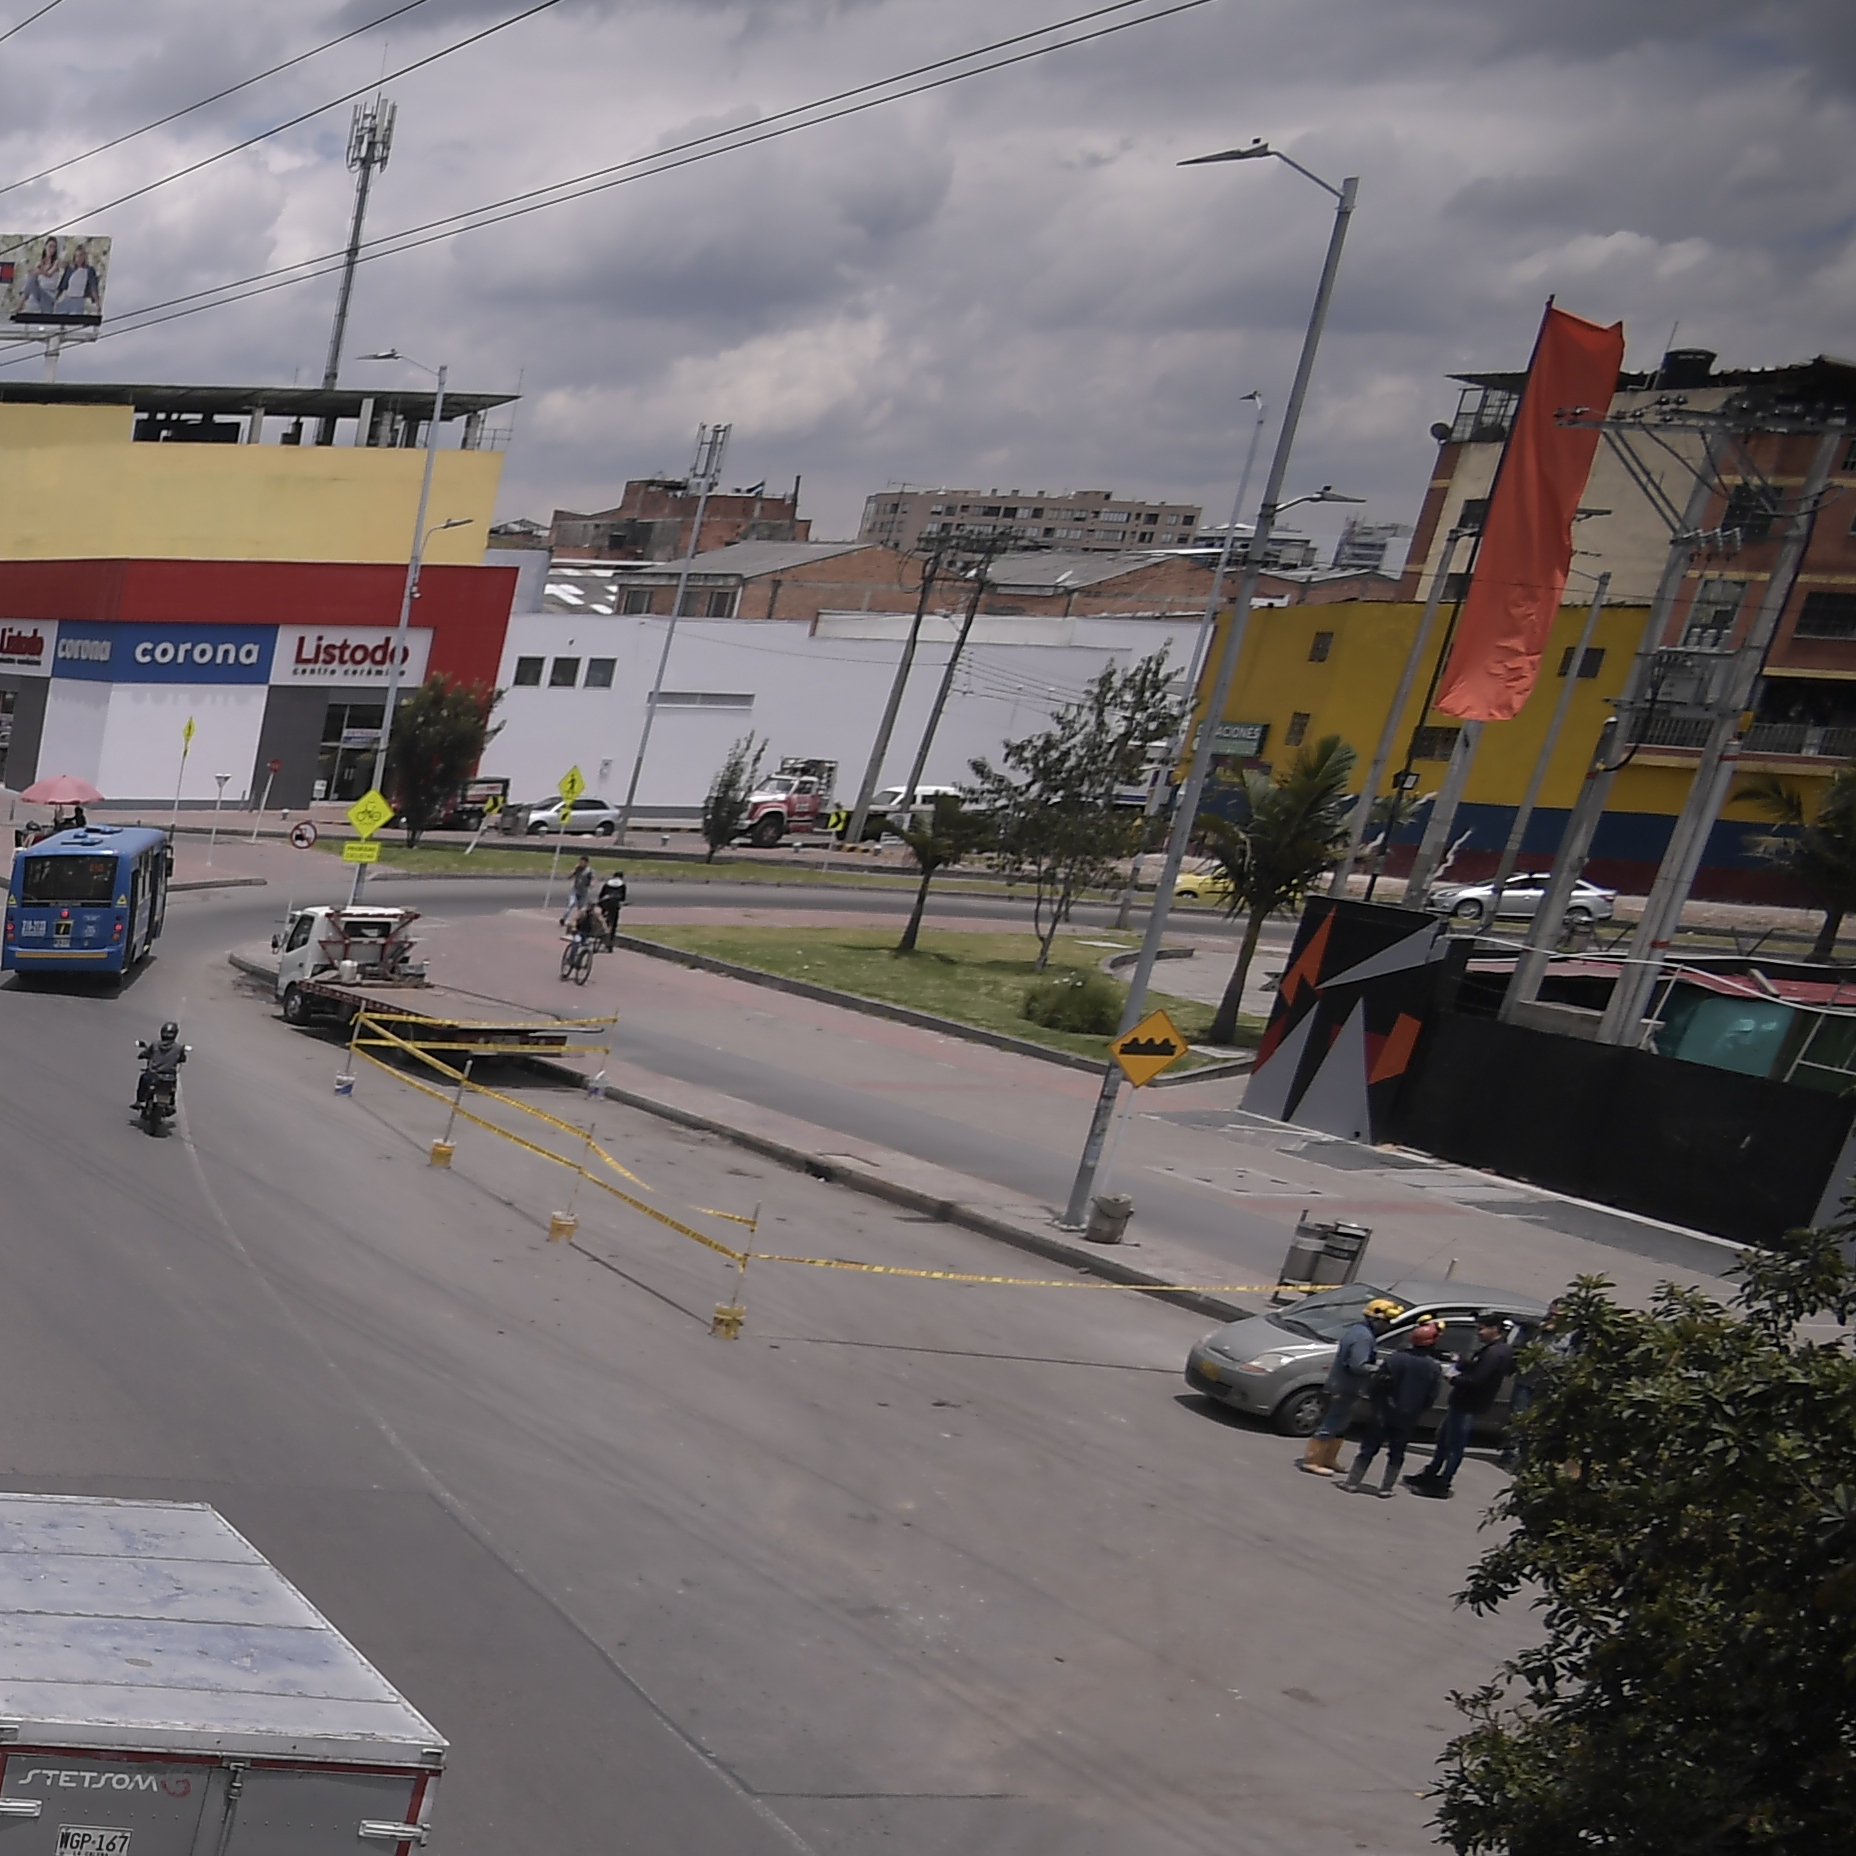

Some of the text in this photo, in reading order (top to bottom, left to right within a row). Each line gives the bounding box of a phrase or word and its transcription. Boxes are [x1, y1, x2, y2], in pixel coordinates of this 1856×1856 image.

[133, 638, 261, 667] corona
[294, 634, 409, 669] Listodo
[18, 1768, 159, 1793] STETSOM
